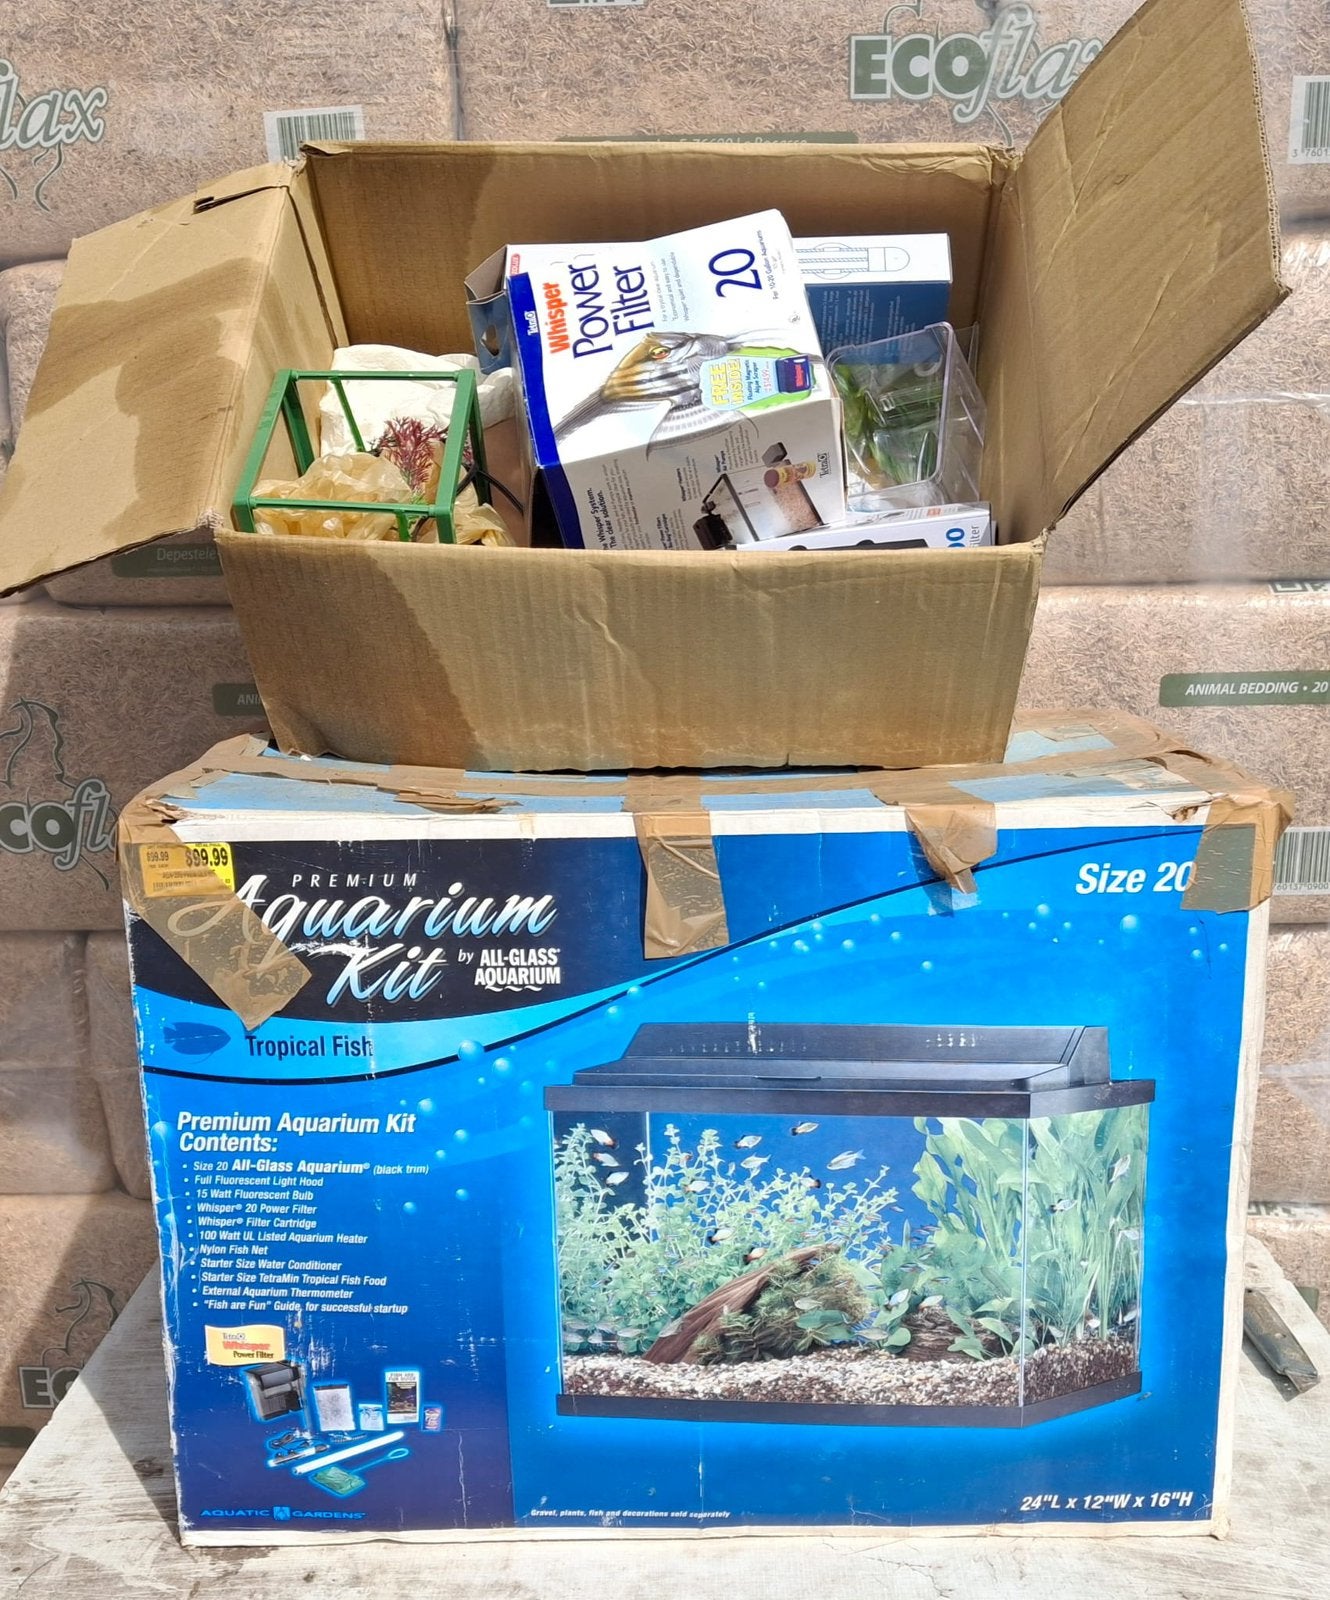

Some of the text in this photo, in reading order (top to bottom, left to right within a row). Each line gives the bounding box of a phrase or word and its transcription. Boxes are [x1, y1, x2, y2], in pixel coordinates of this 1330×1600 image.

[0, 59, 107, 149] lax
[708, 248, 762, 298] 20
[610, 265, 655, 335] Filter
[543, 282, 570, 353] Whisper
[568, 264, 613, 358] Power
[710, 362, 729, 405] FREE
[586, 487, 599, 515] System.
[596, 490, 618, 549] The clear solution.
[156, 547, 216, 563] Depestele
[1185, 680, 1329, 695] ANIMAL BEDDING 20
[185, 847, 229, 868] $99.99
[291, 872, 418, 888] PREMIUM
[1075, 861, 1198, 894] Size 20
[168, 874, 557, 968] Aquarium
[318, 942, 560, 1006] Kit by ALL-GLASS
[474, 967, 561, 989] AQUARIUM
[245, 1035, 373, 1061] Tropical Fish
[177, 1111, 416, 1137] Premium Aquarium Kit
[179, 1132, 279, 1153] Contents:
[193, 1161, 213, 1171] Size
[216, 1161, 229, 1171] 20
[232, 1158, 294, 1172] All-Glass
[373, 1163, 403, 1175] (black
[406, 1164, 430, 1176] trim)
[195, 1174, 324, 1187] Full Fluorescent Light Hood
[196, 1188, 314, 1200] 15 Watt Fluorescent Bulb
[245, 1203, 258, 1213] 20
[260, 1203, 290, 1214] Power
[292, 1204, 317, 1214] Filter
[246, 1217, 271, 1227] Filter
[273, 1217, 317, 1230] Cartridge
[200, 1230, 368, 1244] 100 Watt UL Listed Aquarium Heater
[200, 1244, 269, 1256] Nylon Fish Net
[200, 1258, 343, 1271] Starter Size Water Conditioner
[201, 1271, 388, 1286] Starter Size TetraMin Tropical Fish Food
[202, 1285, 354, 1299] External Aquarium Thermometer
[204, 1299, 228, 1310] "Fish
[230, 1301, 246, 1310] are
[248, 1300, 272, 1310] Fun"
[305, 1301, 320, 1312] for
[321, 1302, 373, 1313] successful
[374, 1303, 409, 1315] startup
[233, 1350, 274, 1359] Power Filter
[1020, 1491, 1194, 1511] 24"L x 12"W x 16"H
[200, 1509, 363, 1519] AQUATIC GARDENS
[530, 1509, 731, 1519] Gravel, plants, fish and decorations sold separately
